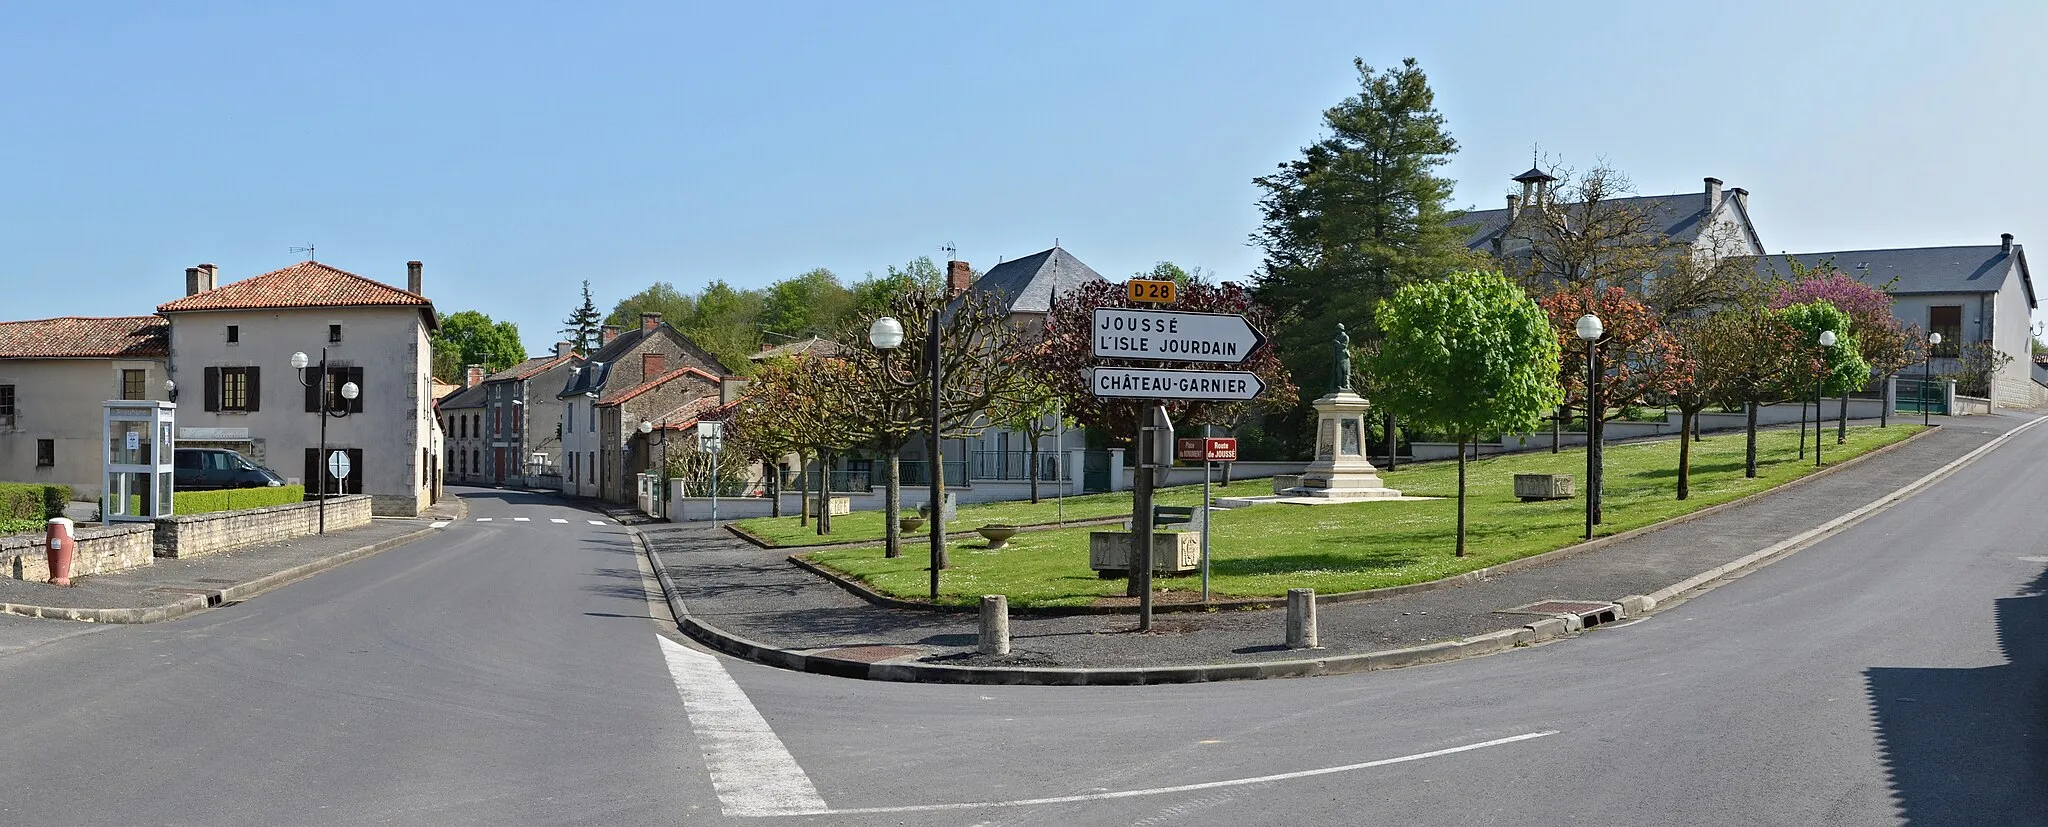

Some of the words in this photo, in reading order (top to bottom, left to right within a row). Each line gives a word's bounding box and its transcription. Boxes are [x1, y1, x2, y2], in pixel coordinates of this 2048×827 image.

[1134, 284, 1144, 297] D
[1149, 284, 1169, 298] 28
[1101, 317, 1178, 333] JOUSSÉ
[1101, 336, 1149, 351] L'ISLE
[1159, 339, 1237, 356] JOURDAIN
[1100, 373, 1247, 393] CHÂTEAU-GARNIER
[1214, 441, 1229, 449] Route
[1215, 449, 1236, 458] JOUSSÉ
